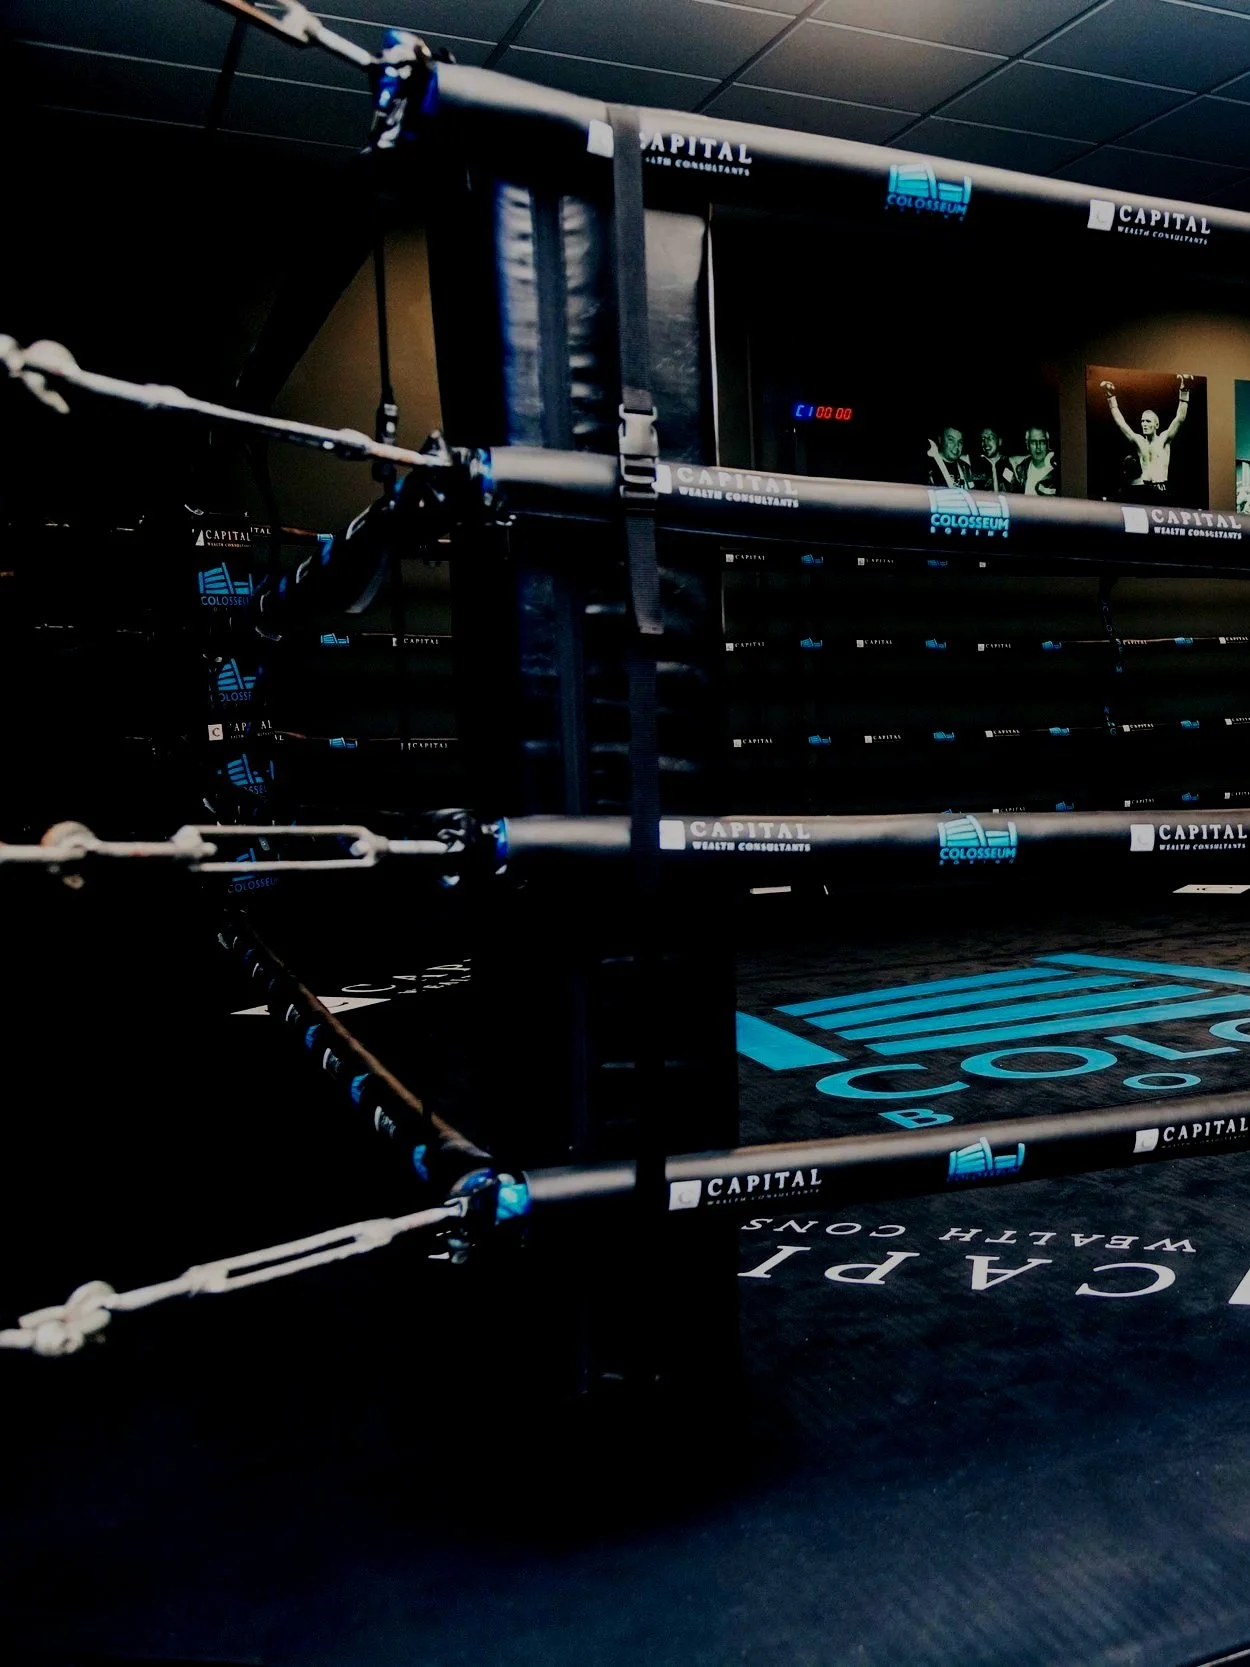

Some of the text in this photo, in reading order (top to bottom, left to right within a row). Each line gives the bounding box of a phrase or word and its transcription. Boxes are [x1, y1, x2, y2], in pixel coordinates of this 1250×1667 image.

[886, 193, 968, 216] COLOSSEUM
[1119, 204, 1211, 236] CAPITAL
[1117, 225, 1208, 246] WEALTH CONSULTANTS
[677, 466, 800, 496] CAPITAL
[678, 487, 800, 509] WEALTH CONSULTANTS
[931, 512, 1009, 532] COLOSSEUM
[1151, 508, 1242, 530] CAPITAL
[206, 529, 251, 542] CAPITAL
[250, 526, 273, 536] ITAL
[1154, 526, 1243, 541] WEALTH CONSULTANTS
[201, 595, 249, 606] COLOSSEU
[690, 821, 811, 840] CAPITAL
[1159, 824, 1248, 841] CAPITAL
[692, 841, 812, 852] WEALTH CONSULTANTS
[939, 847, 1017, 860] COLOSSEUM
[1159, 843, 1246, 851] WEALTH CONSULTANTS
[1163, 1117, 1249, 1142] CAPITAL
[707, 1168, 822, 1197] CAPITAL
[739, 1217, 1197, 1253] WEALTH CONS
[737, 1245, 1177, 1298] CAPI
